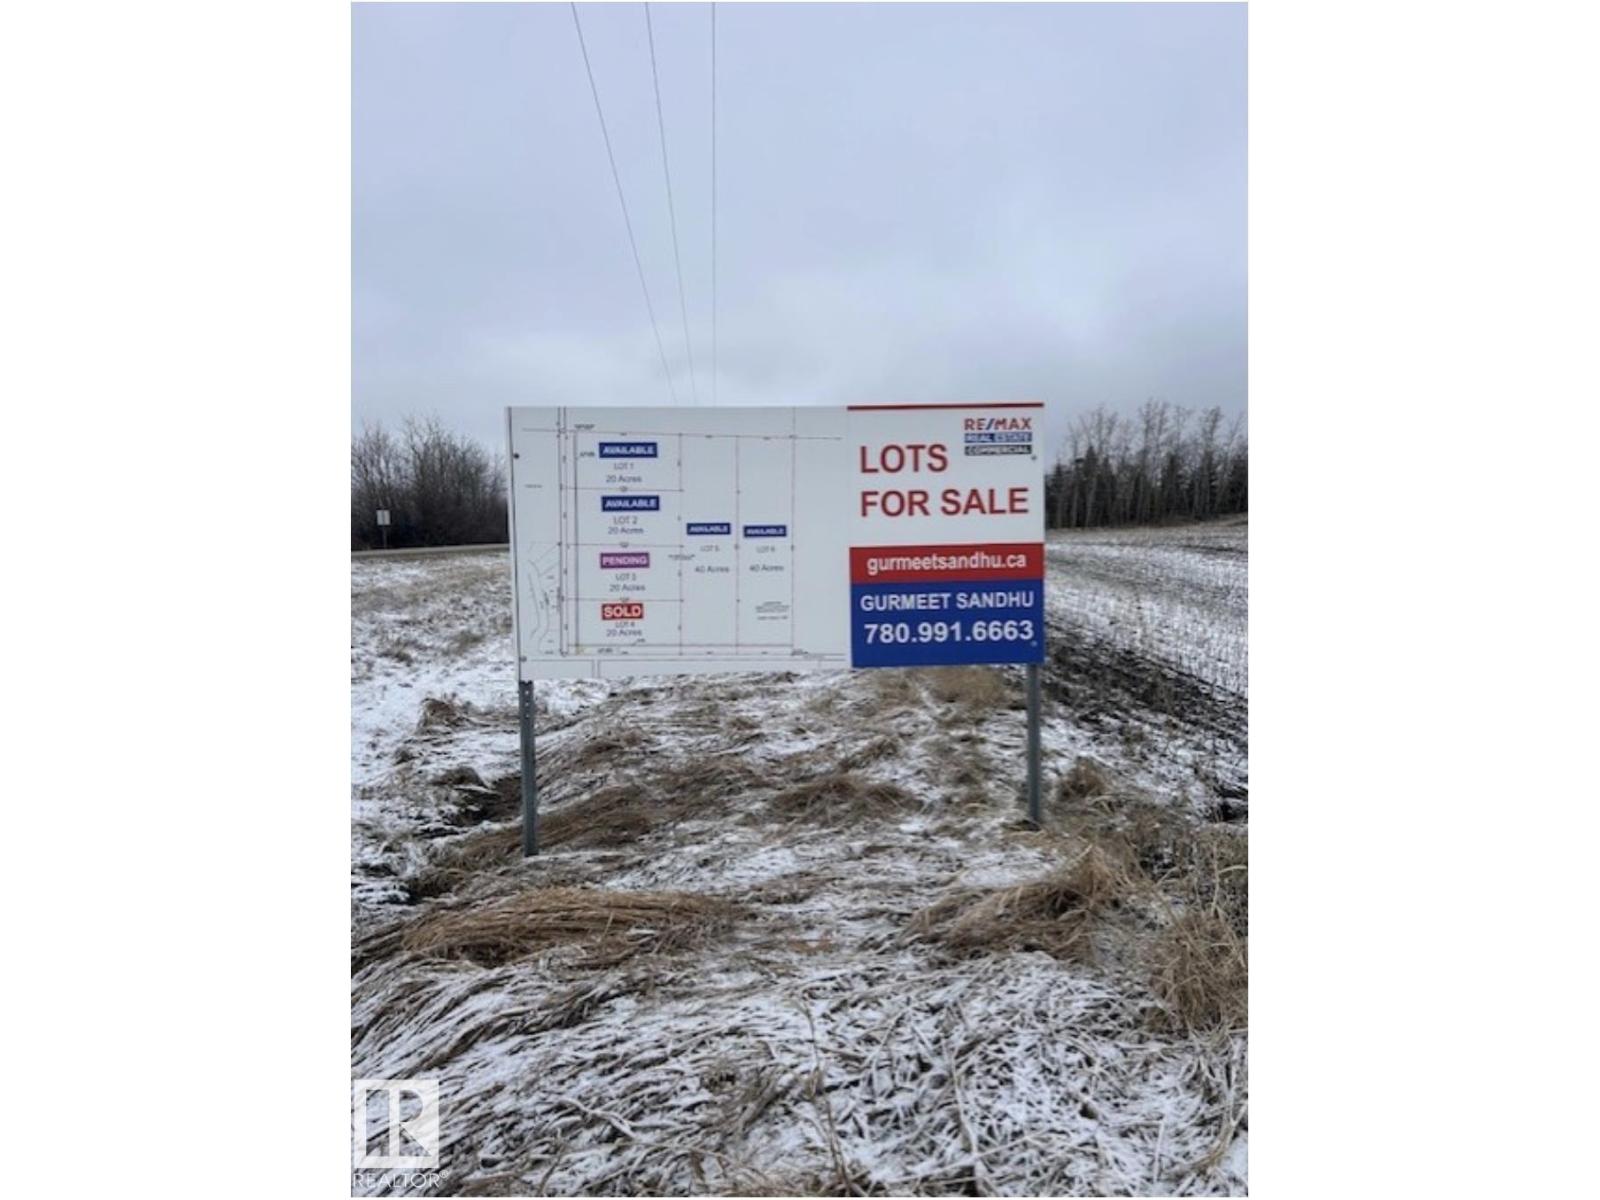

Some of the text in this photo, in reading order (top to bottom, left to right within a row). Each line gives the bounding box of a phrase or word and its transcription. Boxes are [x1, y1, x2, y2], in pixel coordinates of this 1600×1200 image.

[964, 418, 1032, 430] RE/MAX
[602, 445, 654, 455] AVAILABLE
[860, 444, 947, 473] LOTS
[614, 462, 628, 470] LOT
[606, 474, 642, 483] 20 Acres
[604, 498, 656, 508] AVAILABLE
[861, 488, 1029, 517] FOR SALE
[613, 516, 638, 524] LOT 2
[608, 526, 644, 535] 20 Acres
[602, 556, 648, 566] PENDING
[867, 552, 1026, 575] gurmeetsandhu.ca
[708, 565, 730, 573] Acres
[762, 564, 784, 572] Acres
[610, 584, 646, 592] 20 Acres
[860, 590, 1034, 611] GURMEET SANDHU
[604, 606, 642, 618] SOLD
[606, 628, 642, 637] 20 Acres
[864, 620, 1034, 644] 780.991.6663
